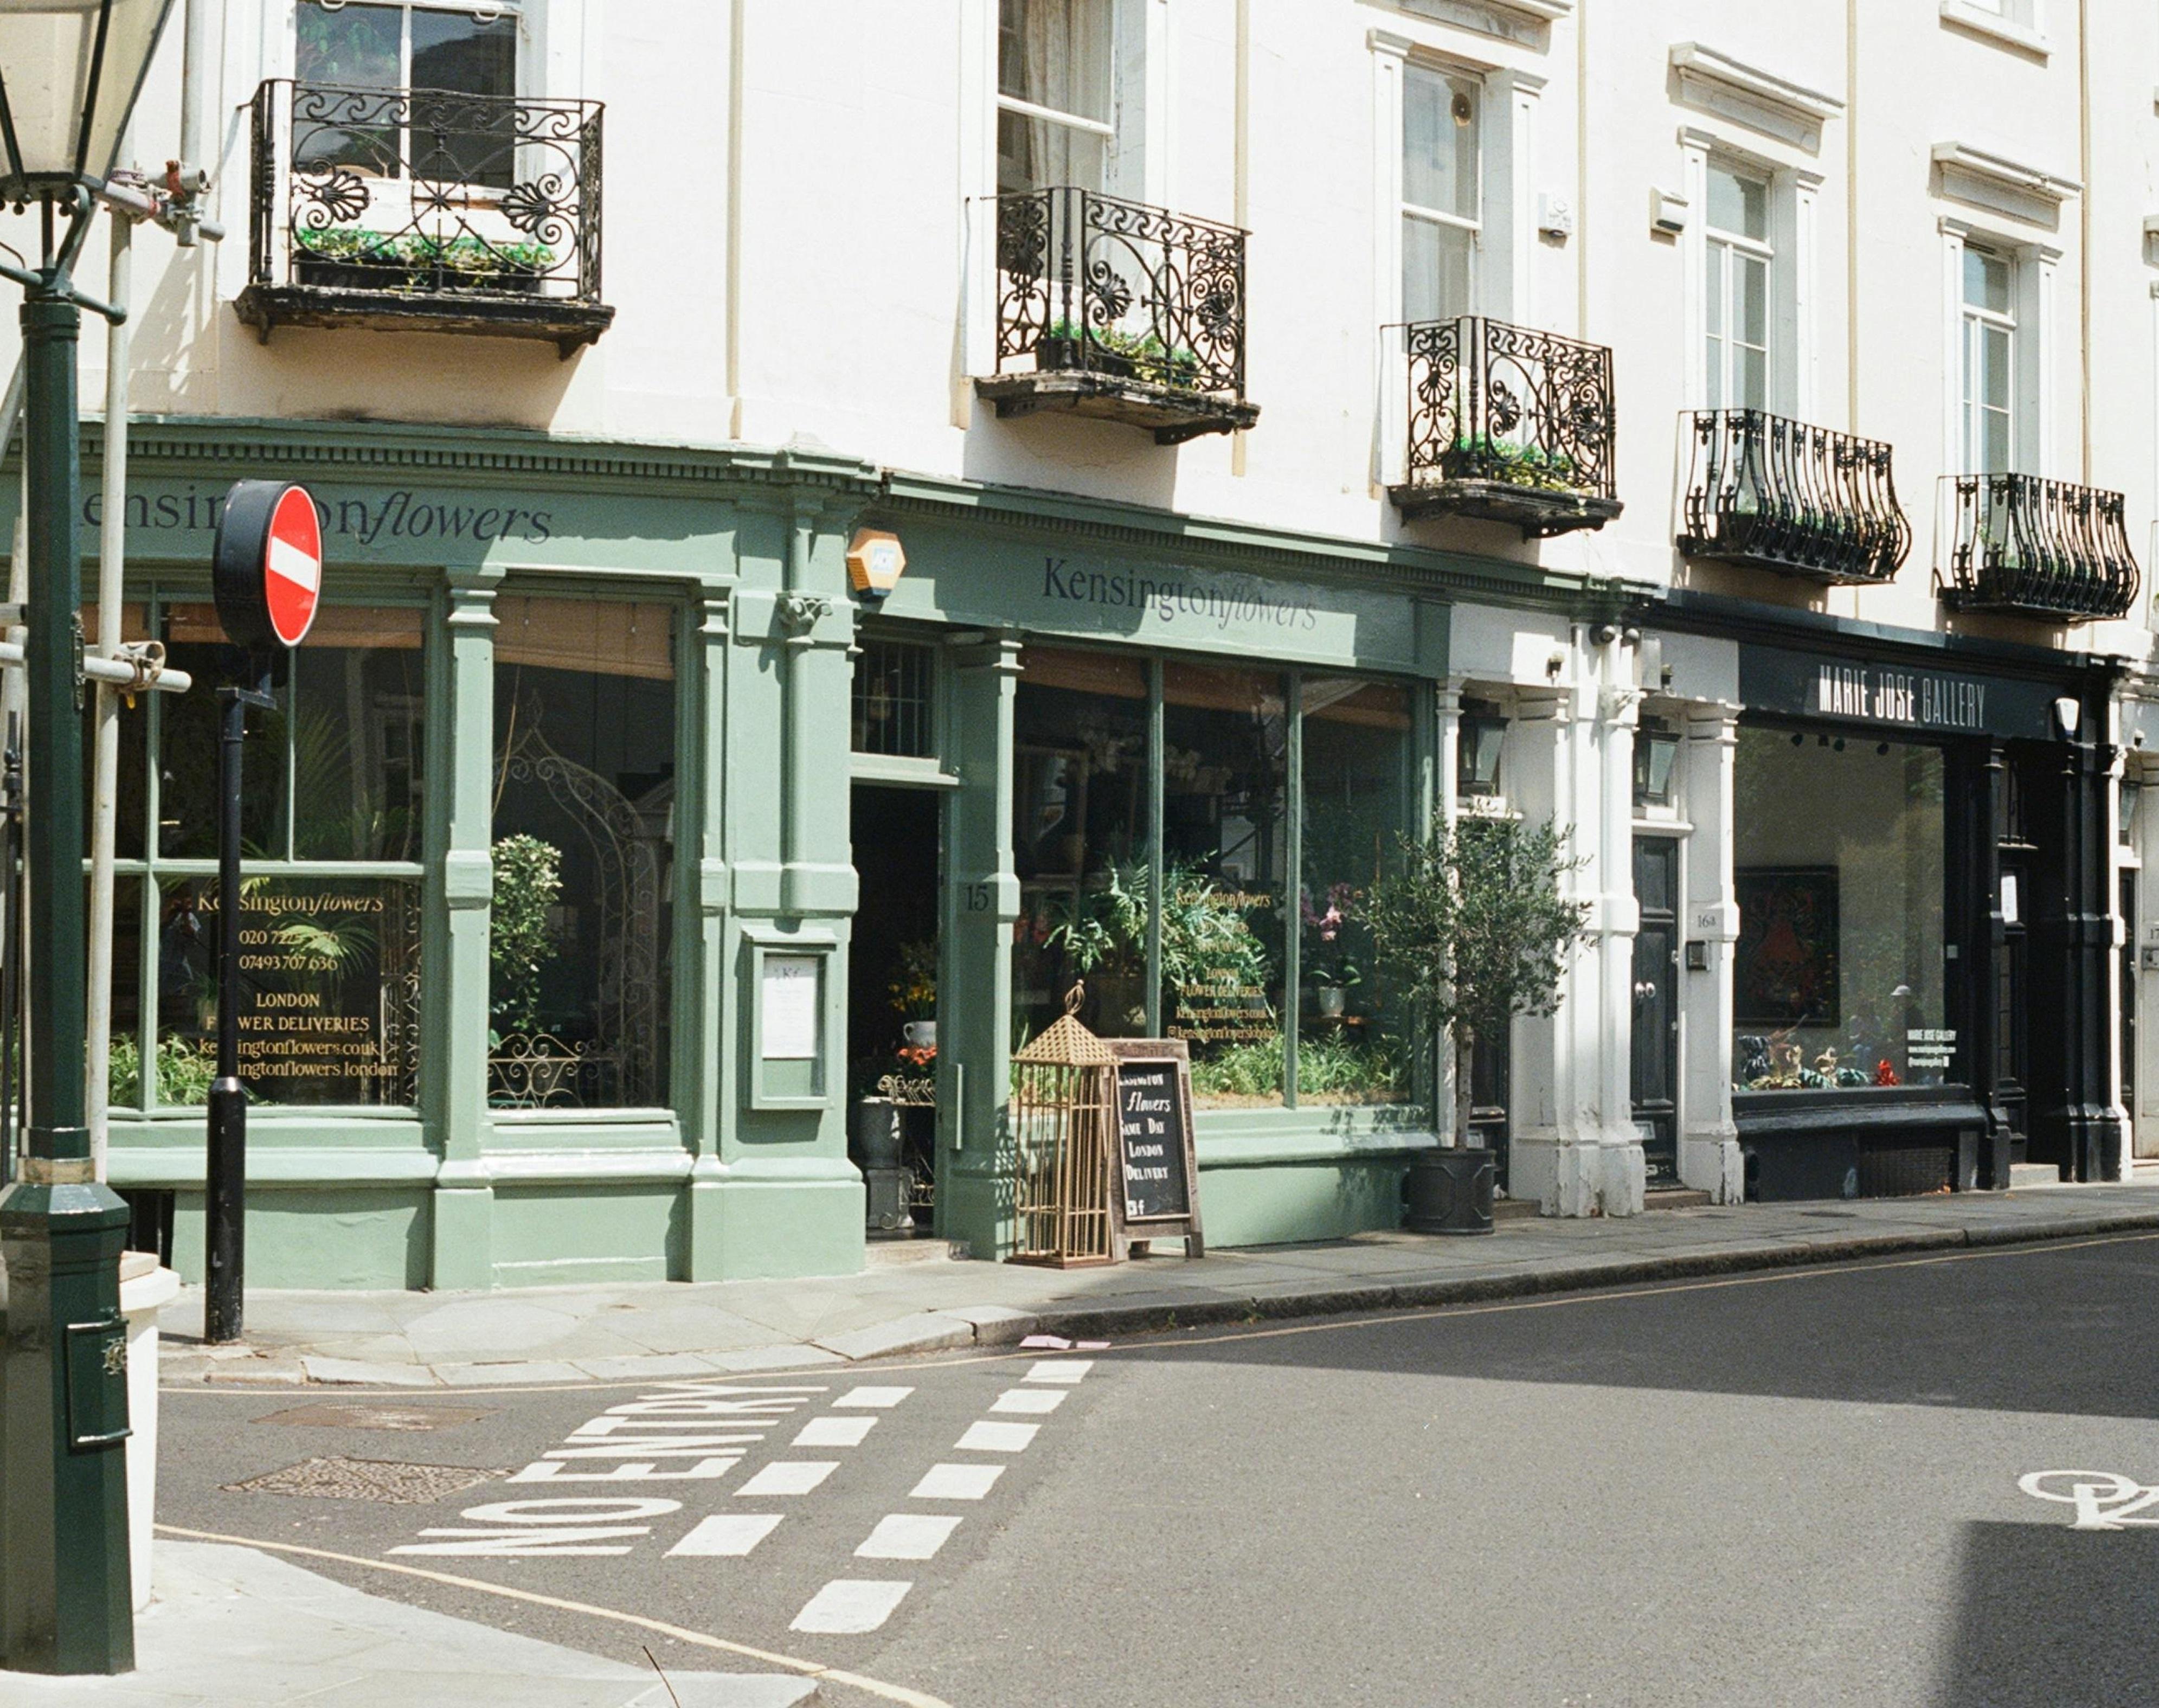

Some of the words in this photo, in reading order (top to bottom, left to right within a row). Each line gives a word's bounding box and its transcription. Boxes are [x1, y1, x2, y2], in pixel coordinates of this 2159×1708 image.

[1044, 557, 1316, 631] Kensingtonflowers
[1819, 665, 1869, 717] MARIE
[1874, 672, 1915, 722] JOSE
[1922, 678, 1985, 728] GALLERY
[967, 883, 989, 912] 15
[239, 930, 267, 945] 020
[239, 955, 280, 969] 07493
[282, 955, 306, 969] 707
[256, 993, 320, 1007] LONDON
[206, 1017, 274, 1031] FWER
[279, 1017, 370, 1032] DELIVERIES
[1126, 1091, 1171, 1112] flowers
[505, 1383, 830, 1484] ENTRY
[385, 1496, 683, 1556] NO
